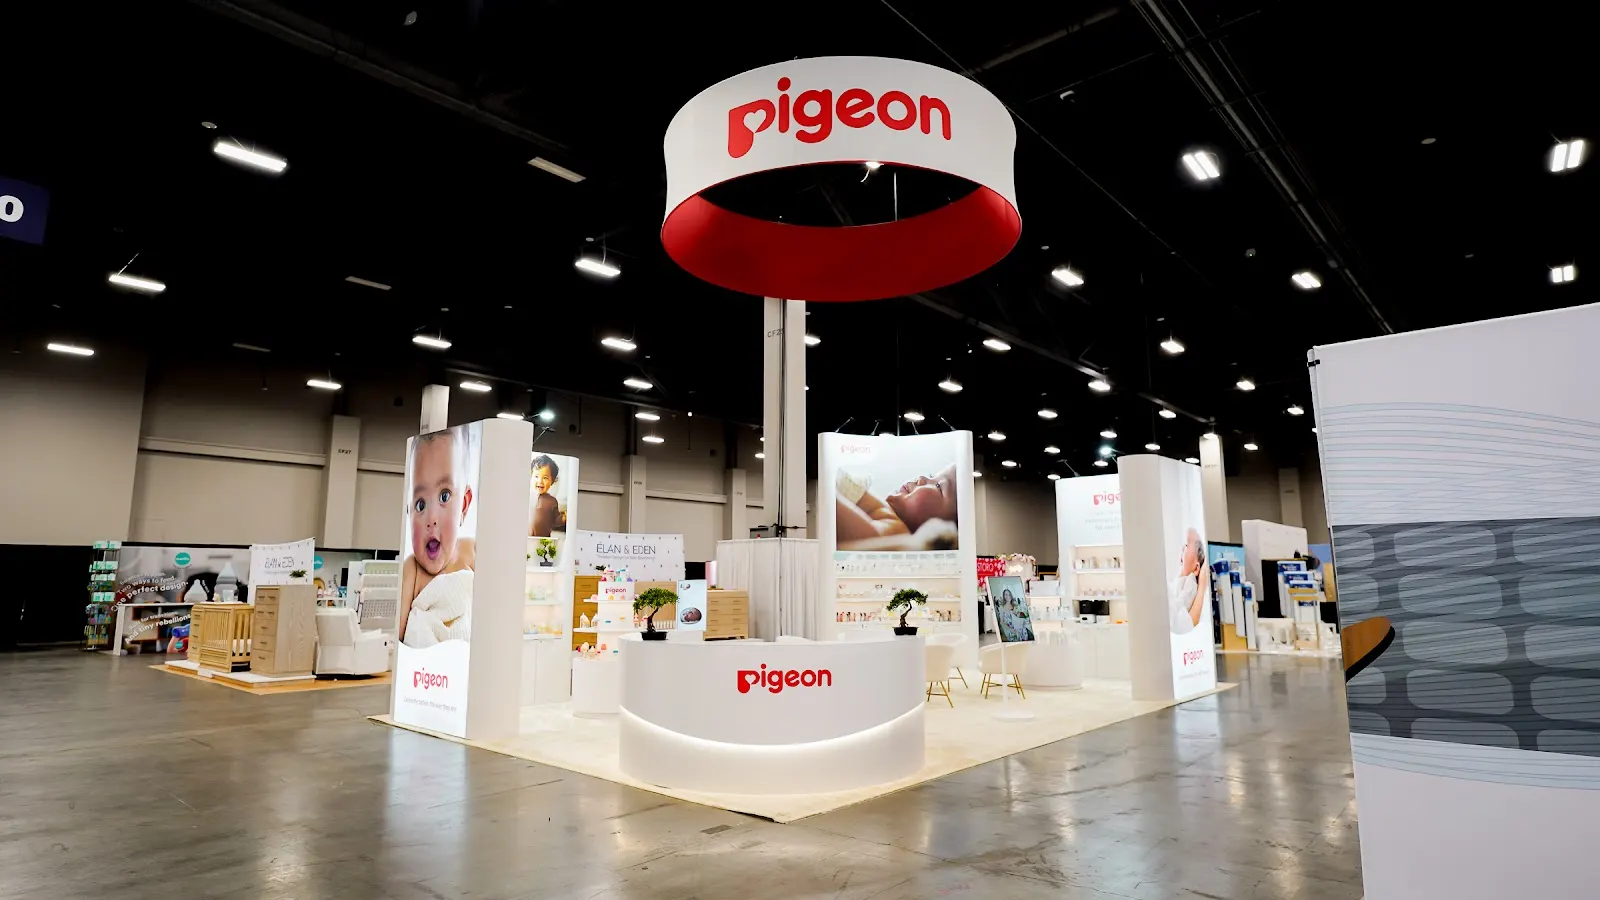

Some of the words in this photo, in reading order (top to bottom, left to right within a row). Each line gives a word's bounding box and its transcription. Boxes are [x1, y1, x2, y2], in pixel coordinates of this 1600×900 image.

[728, 76, 951, 159] pigeon
[632, 545, 656, 555] EDEN
[126, 585, 159, 599] perfect
[160, 581, 189, 592] design.
[132, 578, 151, 587] ways
[124, 630, 139, 645] And
[139, 623, 155, 632] tiny
[413, 667, 449, 690] pigeon
[737, 663, 832, 694] pigeon
